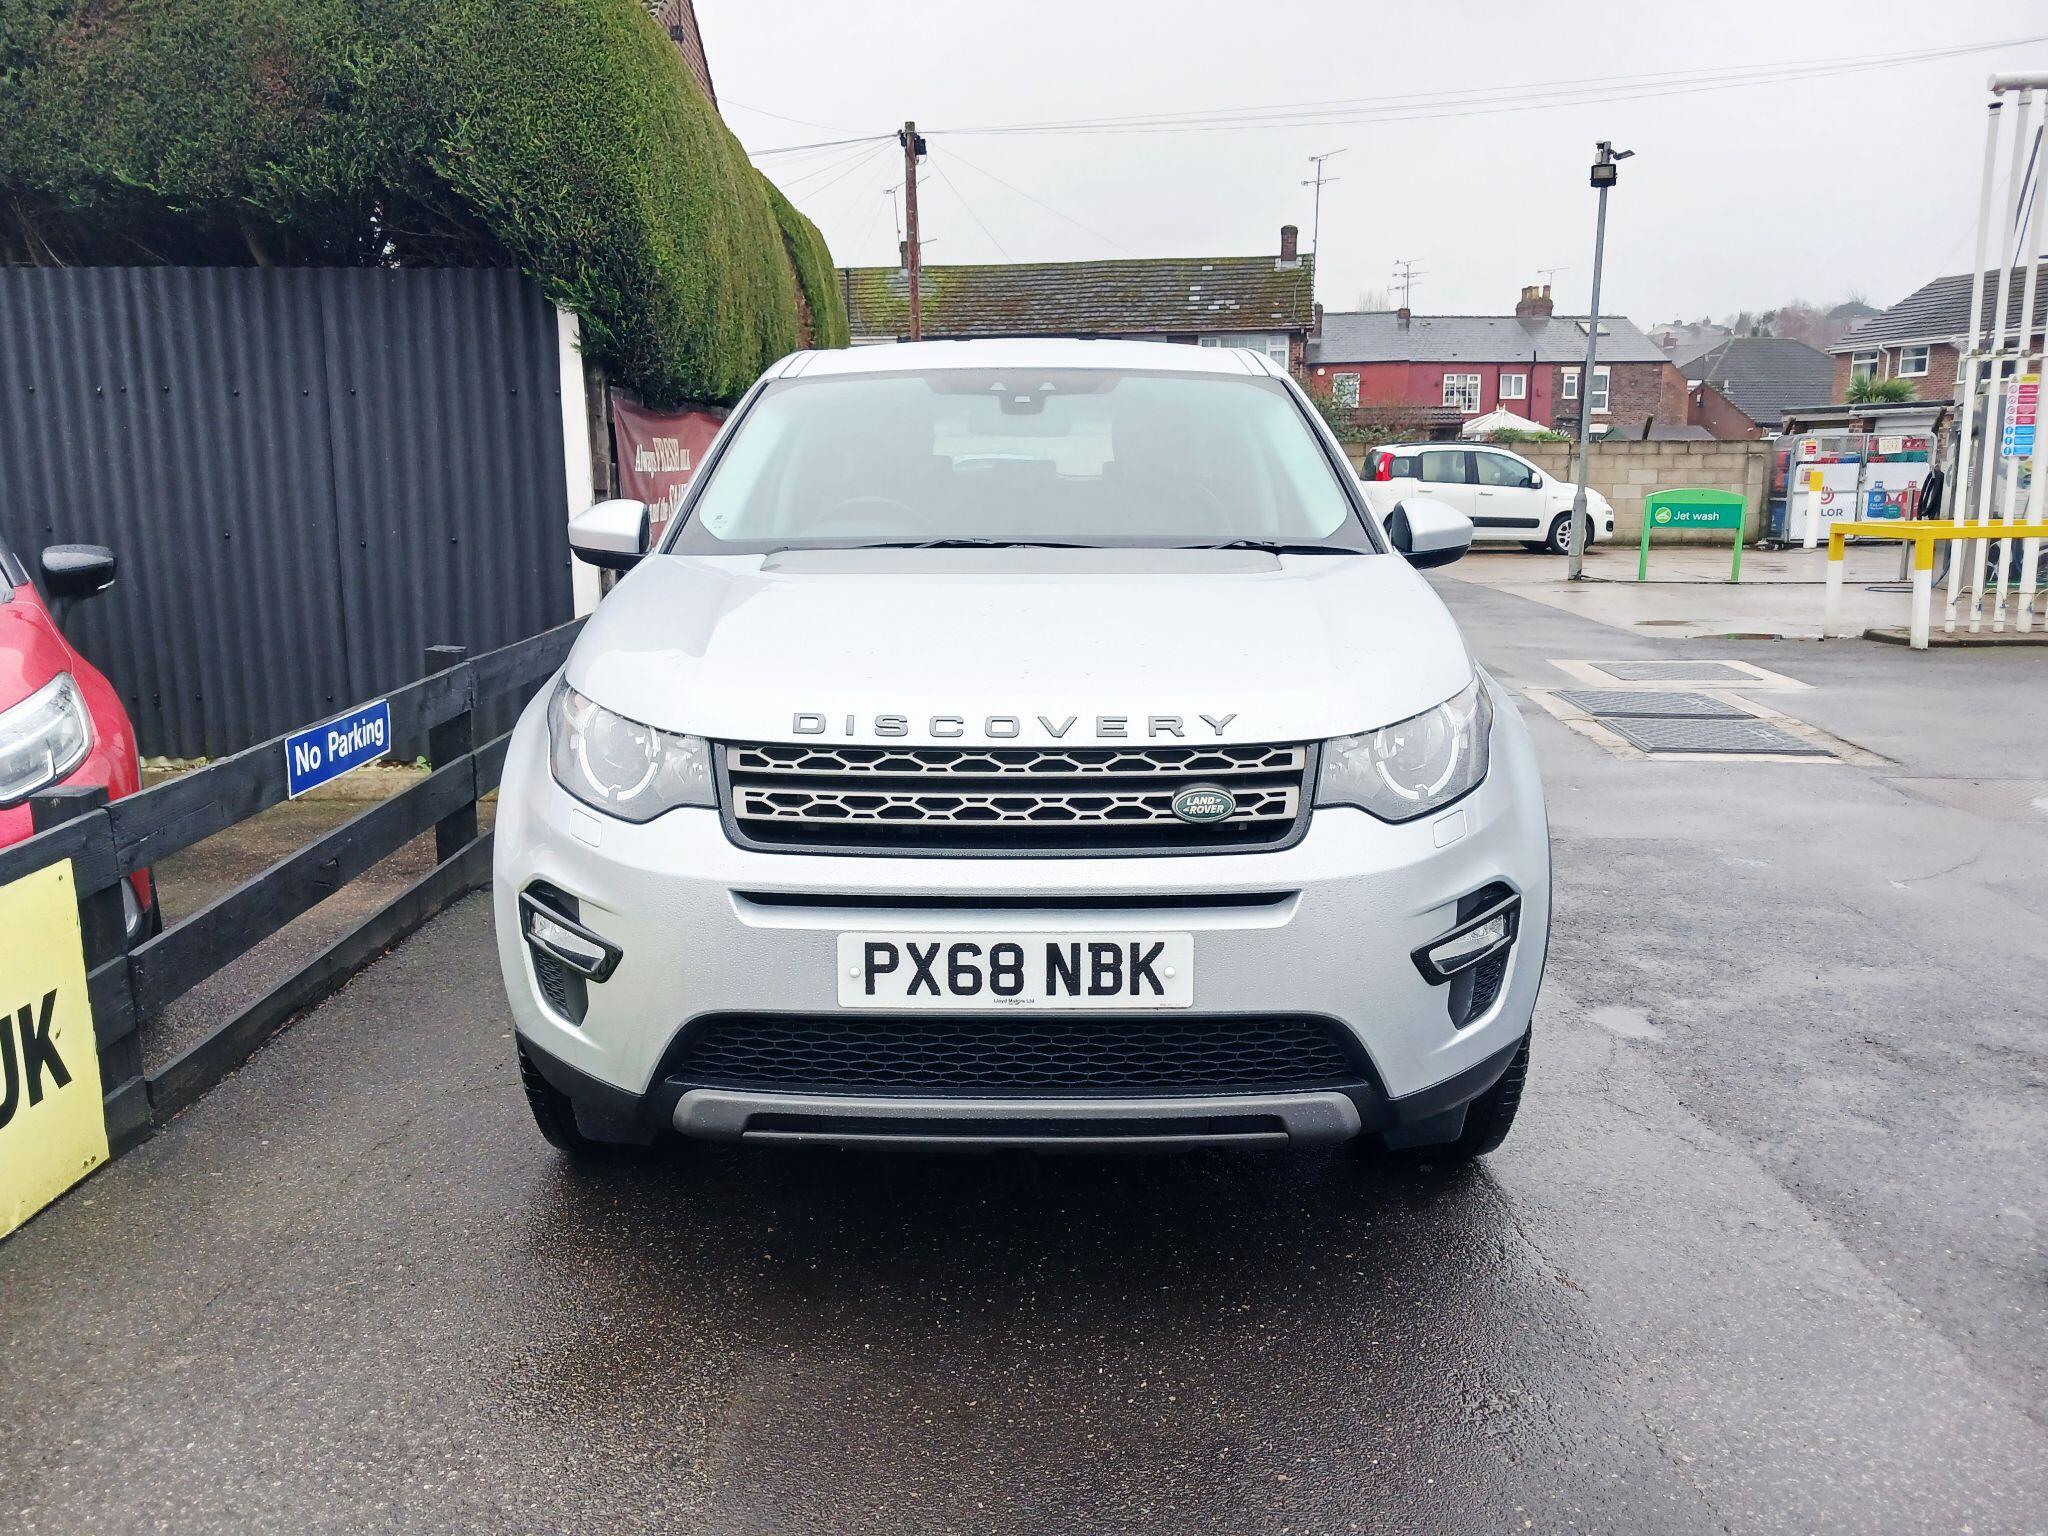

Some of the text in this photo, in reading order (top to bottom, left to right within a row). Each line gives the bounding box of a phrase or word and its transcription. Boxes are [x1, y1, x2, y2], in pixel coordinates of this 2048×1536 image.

[1674, 511, 1719, 521] Jet wash
[1805, 508, 1843, 517] LOR
[793, 712, 1237, 739] DISCOVERY
[294, 718, 384, 776] No Parking
[1186, 796, 1215, 805] LAND
[1189, 804, 1224, 814] ROVER
[864, 941, 1165, 996] PX68 NBK
